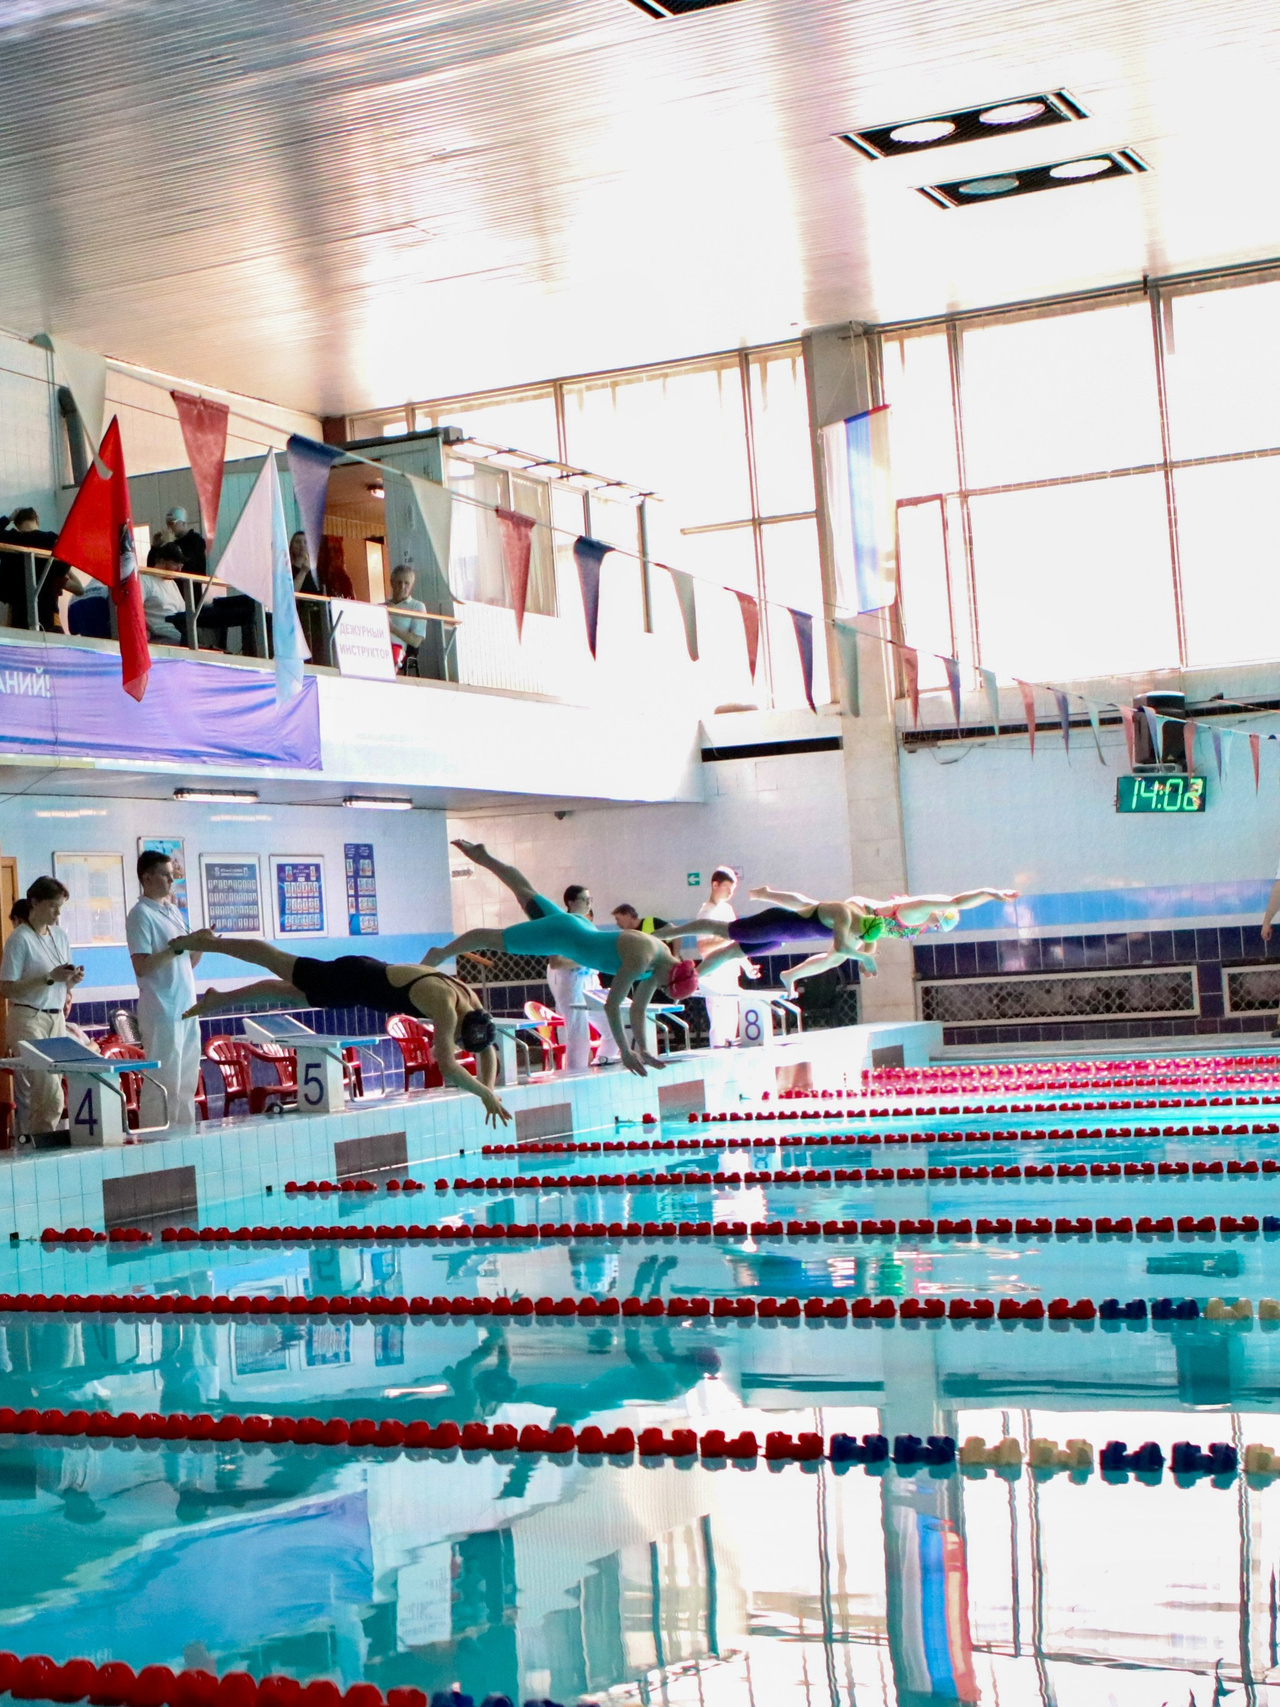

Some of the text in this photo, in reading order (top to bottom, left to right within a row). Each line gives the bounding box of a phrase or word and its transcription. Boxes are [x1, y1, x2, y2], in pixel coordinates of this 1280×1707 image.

[339, 643, 390, 660] ИНСТРУКТОР
[1131, 778, 1204, 811] 14:02
[745, 1009, 761, 1041] 8
[303, 1063, 324, 1105] 5
[74, 1087, 98, 1136] 4
